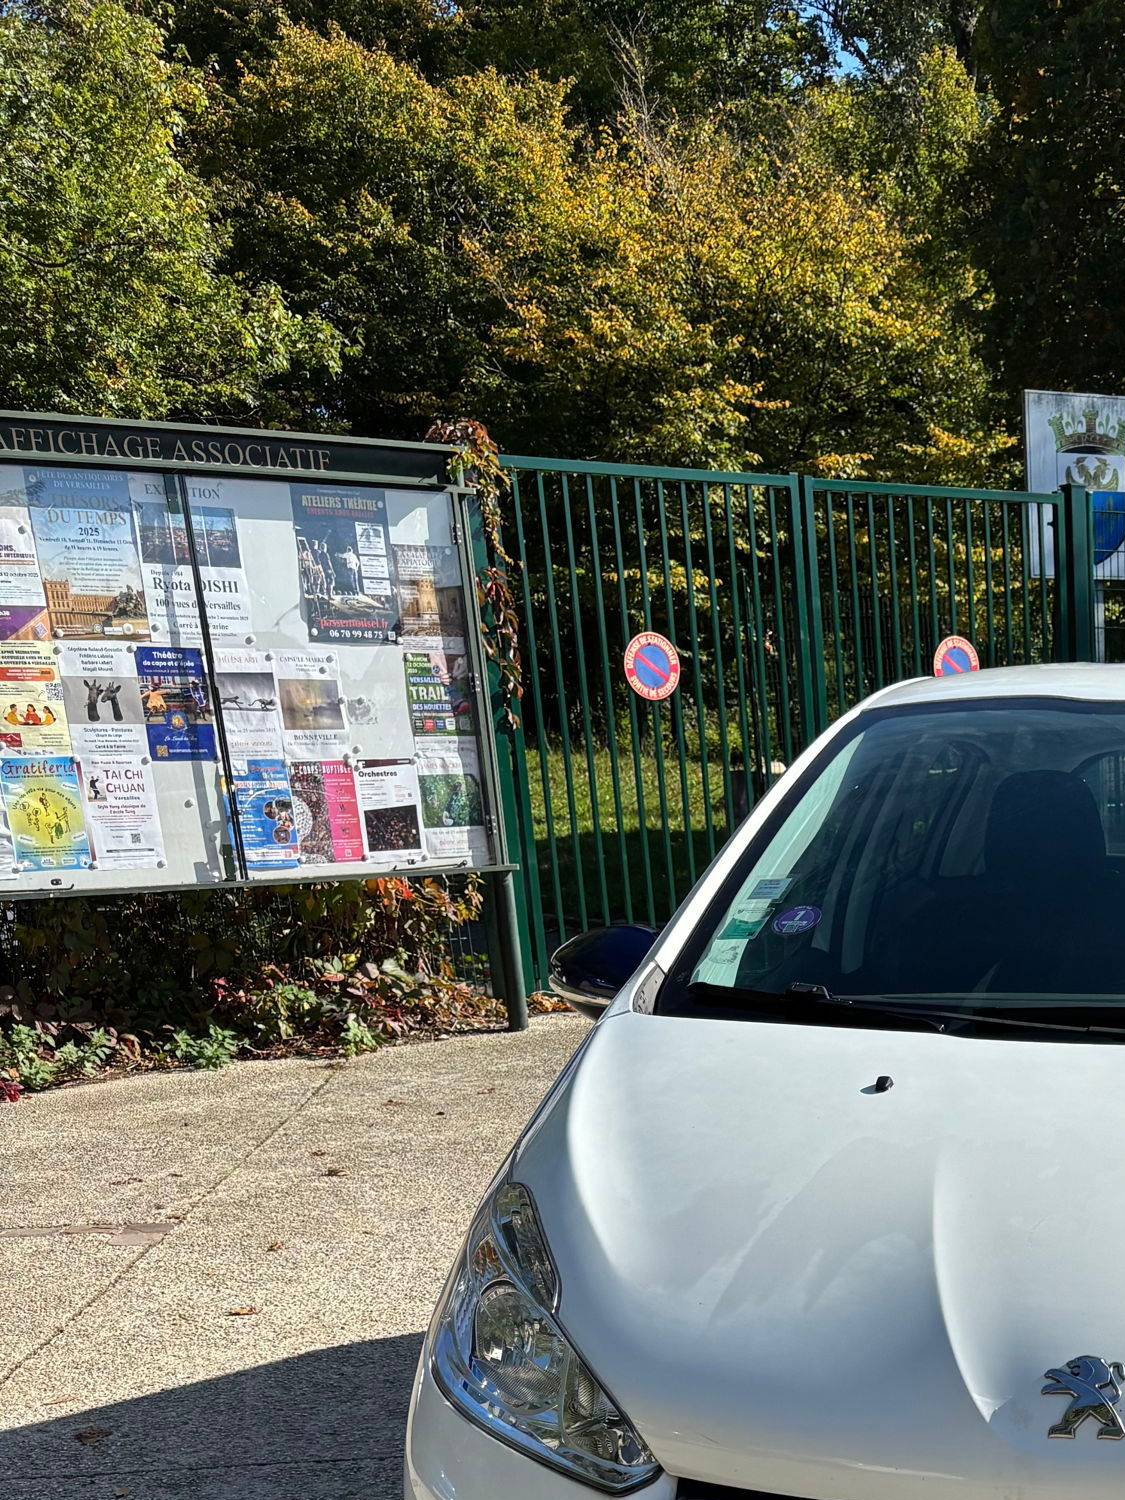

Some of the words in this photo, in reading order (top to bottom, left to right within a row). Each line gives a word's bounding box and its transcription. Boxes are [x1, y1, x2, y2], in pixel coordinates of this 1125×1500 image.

[172, 440, 331, 471] ASSOCIATIF
[145, 483, 220, 499] EXTION
[47, 509, 71, 524] DU
[74, 510, 127, 526] TEMPS
[78, 527, 100, 536] 2025
[153, 577, 191, 593] Ryota
[329, 629, 340, 637] 06
[341, 629, 351, 638] 70
[352, 630, 362, 638] 99
[363, 630, 373, 638] 48
[374, 631, 383, 639] 75
[152, 650, 183, 659] Théâtre
[409, 686, 449, 701] TRAIL
[1, 760, 75, 776] Gratiferia
[102, 769, 122, 780] TAI
[124, 769, 144, 780] CHI
[358, 770, 398, 778] Orchestres
[106, 782, 145, 793] CHUAN
